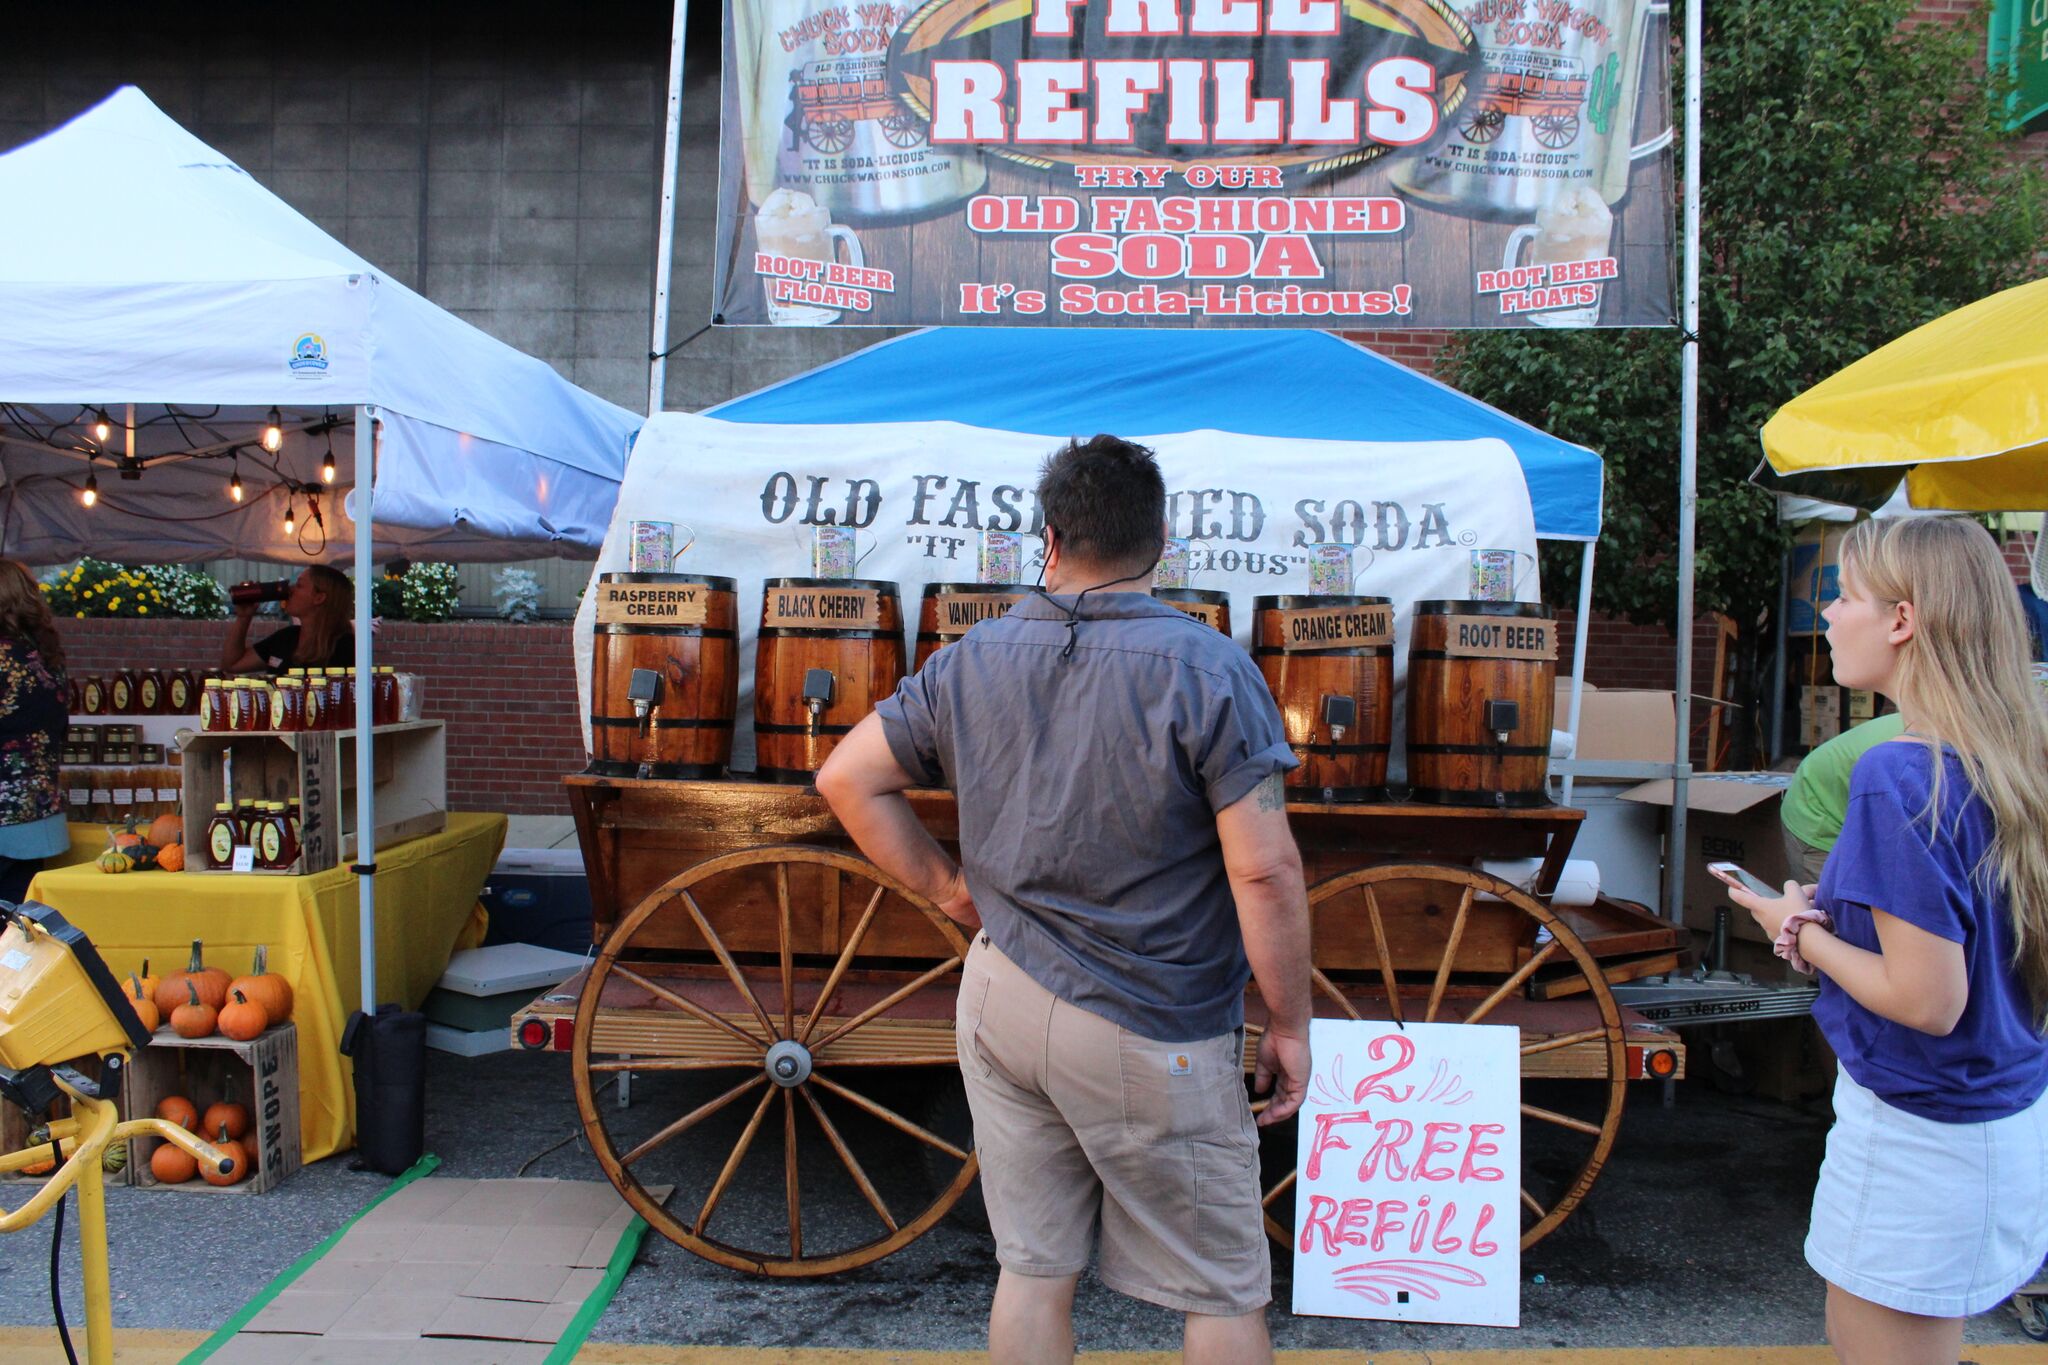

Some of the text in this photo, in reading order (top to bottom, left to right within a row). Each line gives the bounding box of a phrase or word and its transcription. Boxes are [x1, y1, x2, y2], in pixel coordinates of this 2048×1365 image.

[1495, 19, 1565, 49] SODA
[930, 56, 1439, 146] REFILLS
[825, 159, 837, 169] IS
[1467, 148, 1480, 160] IS
[1074, 165, 1285, 190] TRY OUR
[967, 195, 1406, 234] OLD FASHIONED
[1051, 232, 1325, 280] SODA
[755, 252, 895, 292] ROOT BEER
[1477, 257, 1618, 293] ROOT BEER
[776, 279, 872, 311] FLOATS
[959, 283, 1413, 315] It's Soda-Licious!
[1500, 283, 1597, 314] FLOATS
[760, 471, 883, 528] OLD
[609, 590, 696, 603] RASPBERRY
[627, 604, 678, 616] CREAM
[778, 595, 865, 619] BLACK CHERRY
[948, 602, 994, 625] VANILLA
[1292, 612, 1386, 641] ORANGE CREAM
[1460, 624, 1545, 650] ROOT BEER
[1354, 1034, 1415, 1104] 2
[262, 1055, 282, 1170] SWOPE
[1306, 1110, 1505, 1183] FREE
